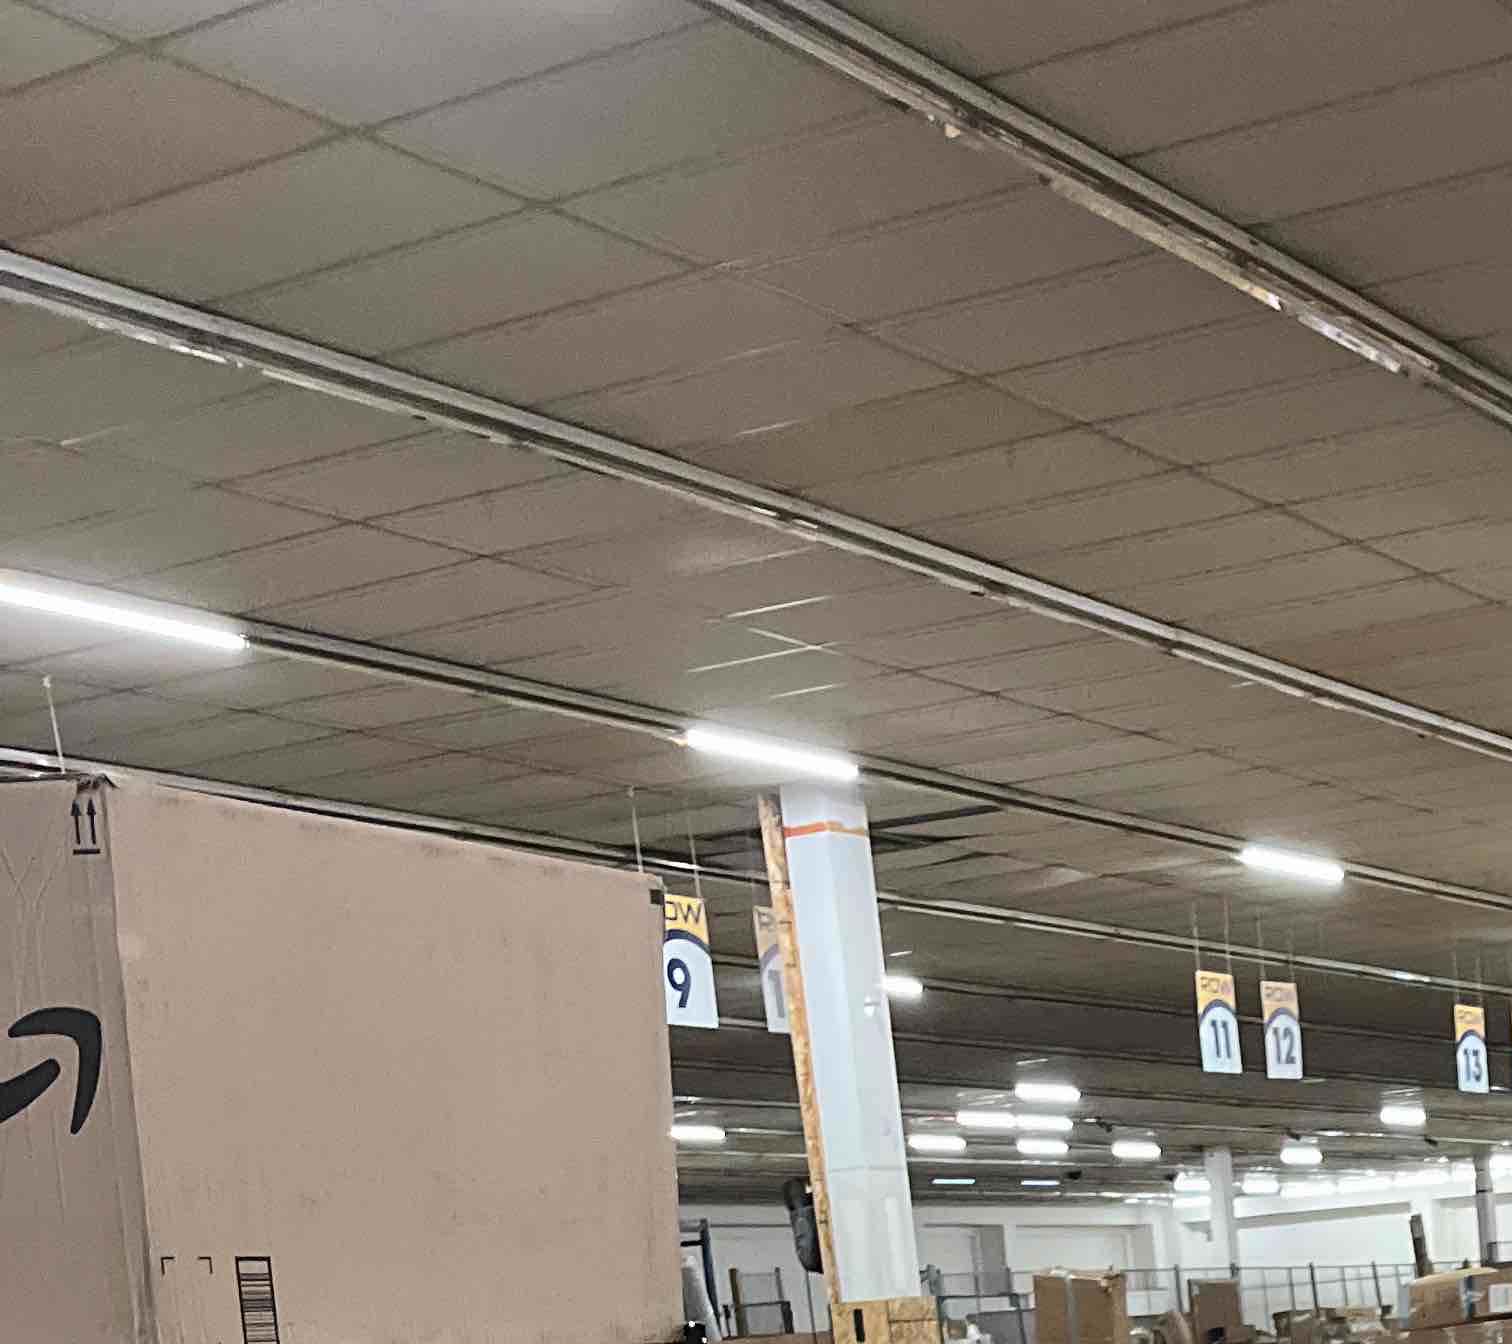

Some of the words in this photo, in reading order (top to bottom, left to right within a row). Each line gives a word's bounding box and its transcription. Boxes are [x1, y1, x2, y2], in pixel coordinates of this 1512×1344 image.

[664, 900, 702, 924] OW
[666, 957, 692, 1009] 9
[768, 969, 786, 1019] 1
[1210, 1020, 1232, 1060] 11
[1272, 1027, 1297, 1065] 12
[1463, 1049, 1482, 1082] 13
